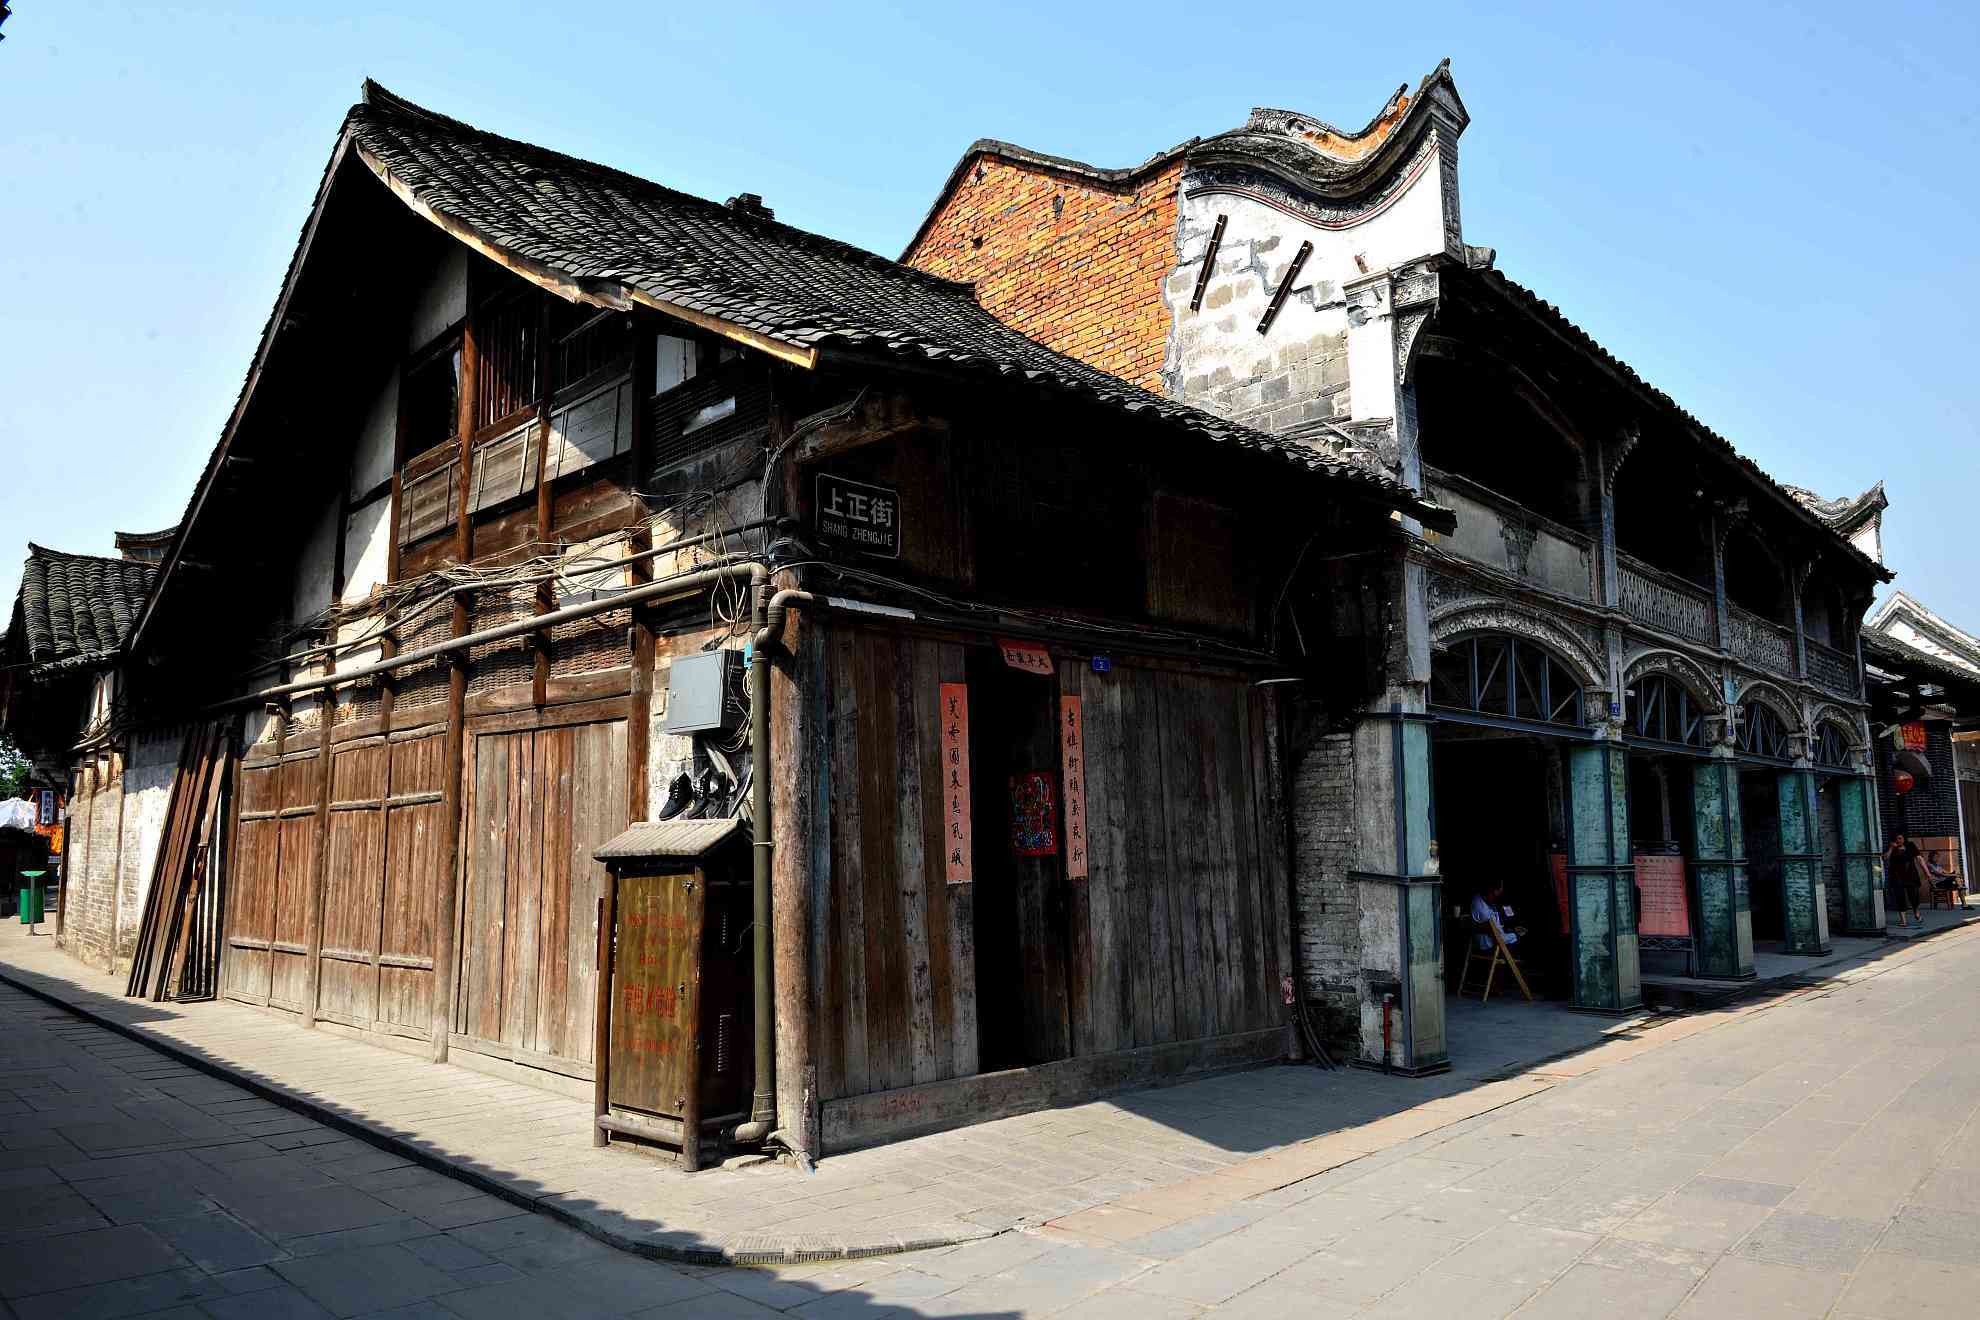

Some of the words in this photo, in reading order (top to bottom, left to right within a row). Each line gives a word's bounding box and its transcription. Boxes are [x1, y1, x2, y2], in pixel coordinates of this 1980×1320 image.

[823, 487, 894, 527] 上正街
[822, 519, 849, 538] SHANG
